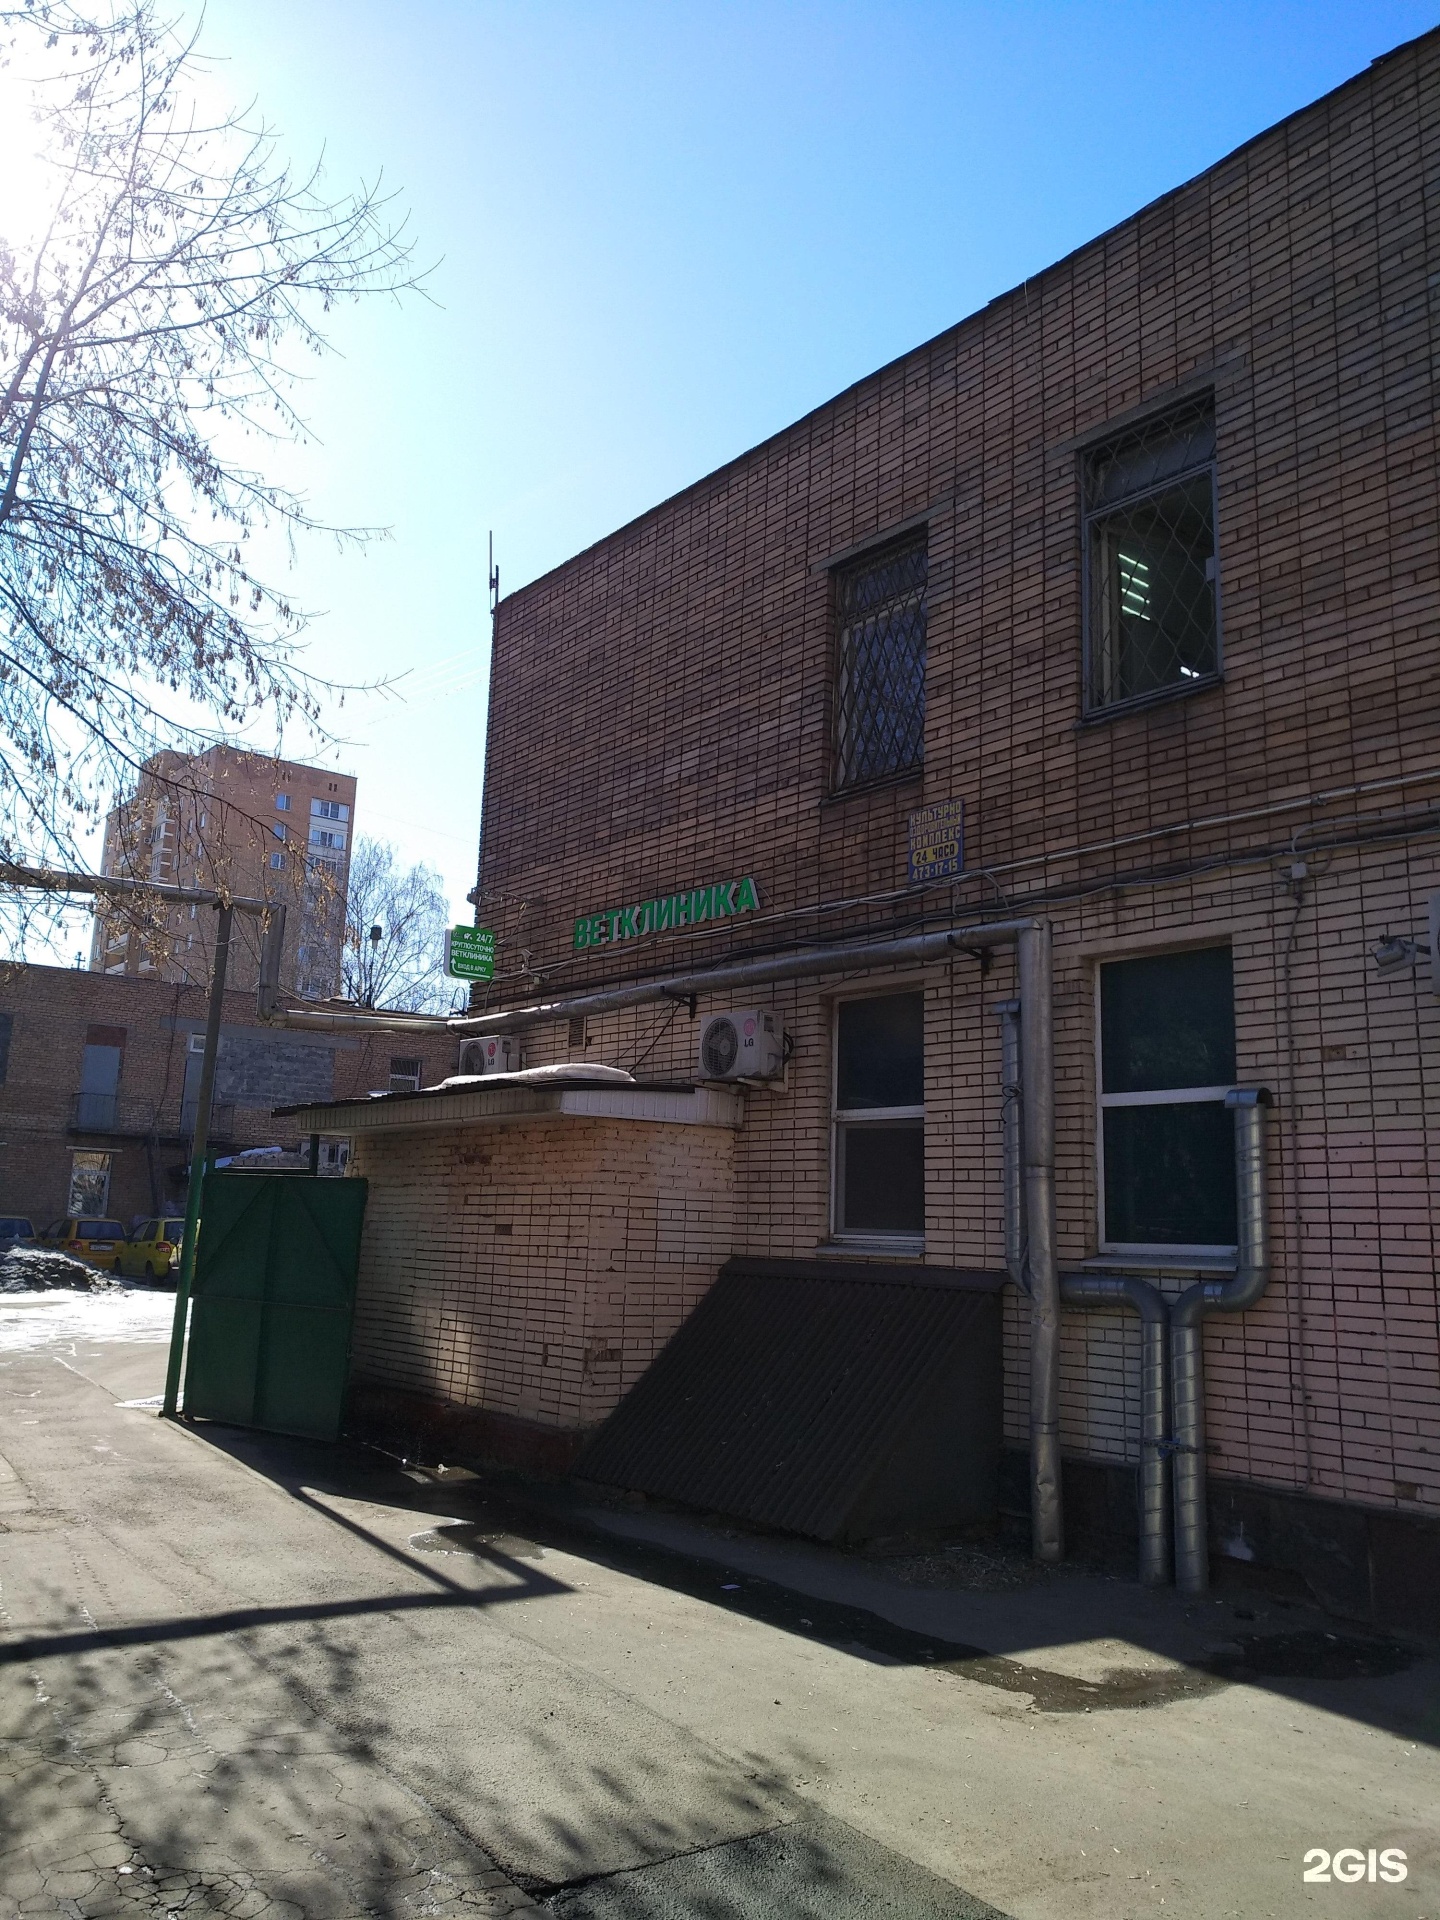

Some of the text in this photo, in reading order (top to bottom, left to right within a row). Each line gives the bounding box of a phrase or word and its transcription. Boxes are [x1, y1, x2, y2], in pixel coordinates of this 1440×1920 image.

[910, 801, 961, 826] КУЛЬТУРНО
[910, 826, 961, 850] КОМПЛЕКС
[915, 843, 955, 864] 24 ЧАСА
[573, 876, 761, 950] ВЕТКЛИНИКА
[476, 933, 493, 943] 24/7
[451, 940, 494, 953] КРУГЛОСУТОЧНО
[451, 950, 493, 962] ВЕТКЛИНИКА
[743, 1037, 754, 1048] LG
[487, 1057, 495, 1066] LG
